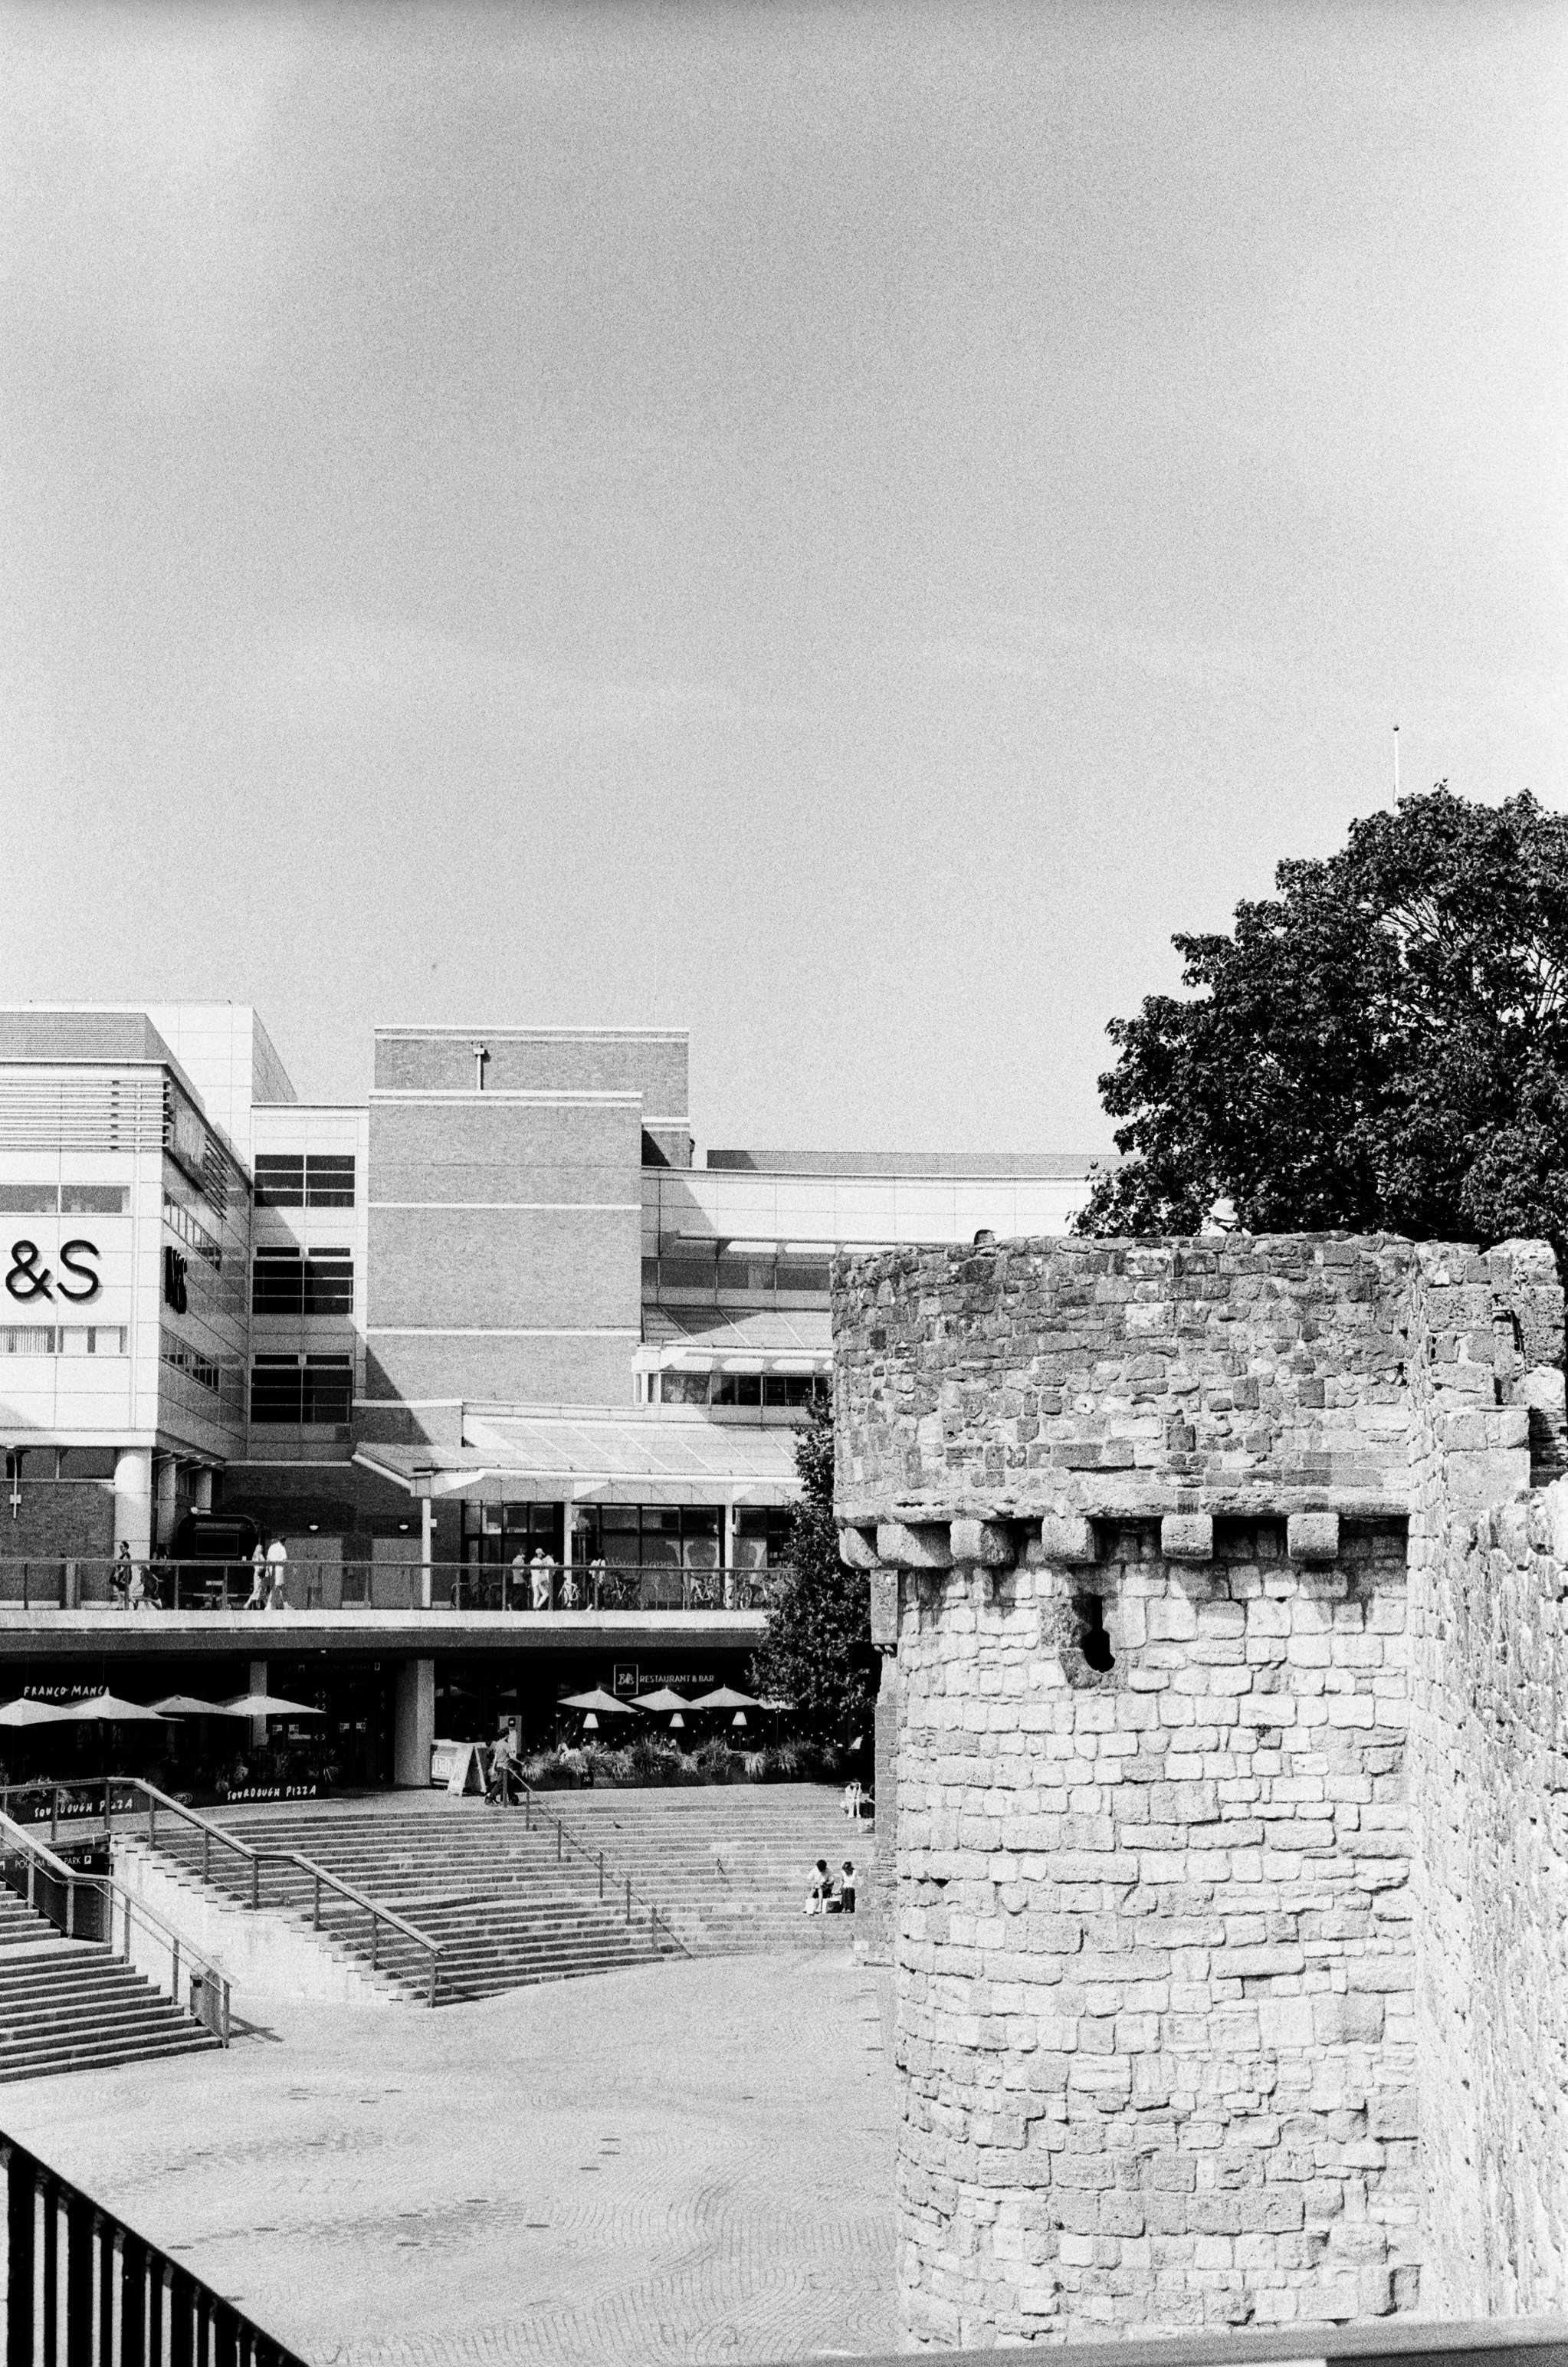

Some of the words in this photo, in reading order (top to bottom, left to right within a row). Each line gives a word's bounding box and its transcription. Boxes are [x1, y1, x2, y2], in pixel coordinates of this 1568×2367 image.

[639, 1675, 691, 1683] RESTAURANT
[691, 1675, 697, 1683] &
[23, 1686, 68, 1698] FRANCO
[227, 1788, 280, 1801] SOURDOUGH
[286, 1784, 317, 1797] PIZZA
[34, 1803, 93, 1817] SOUDOUGH
[99, 1798, 133, 1812] PZZA
